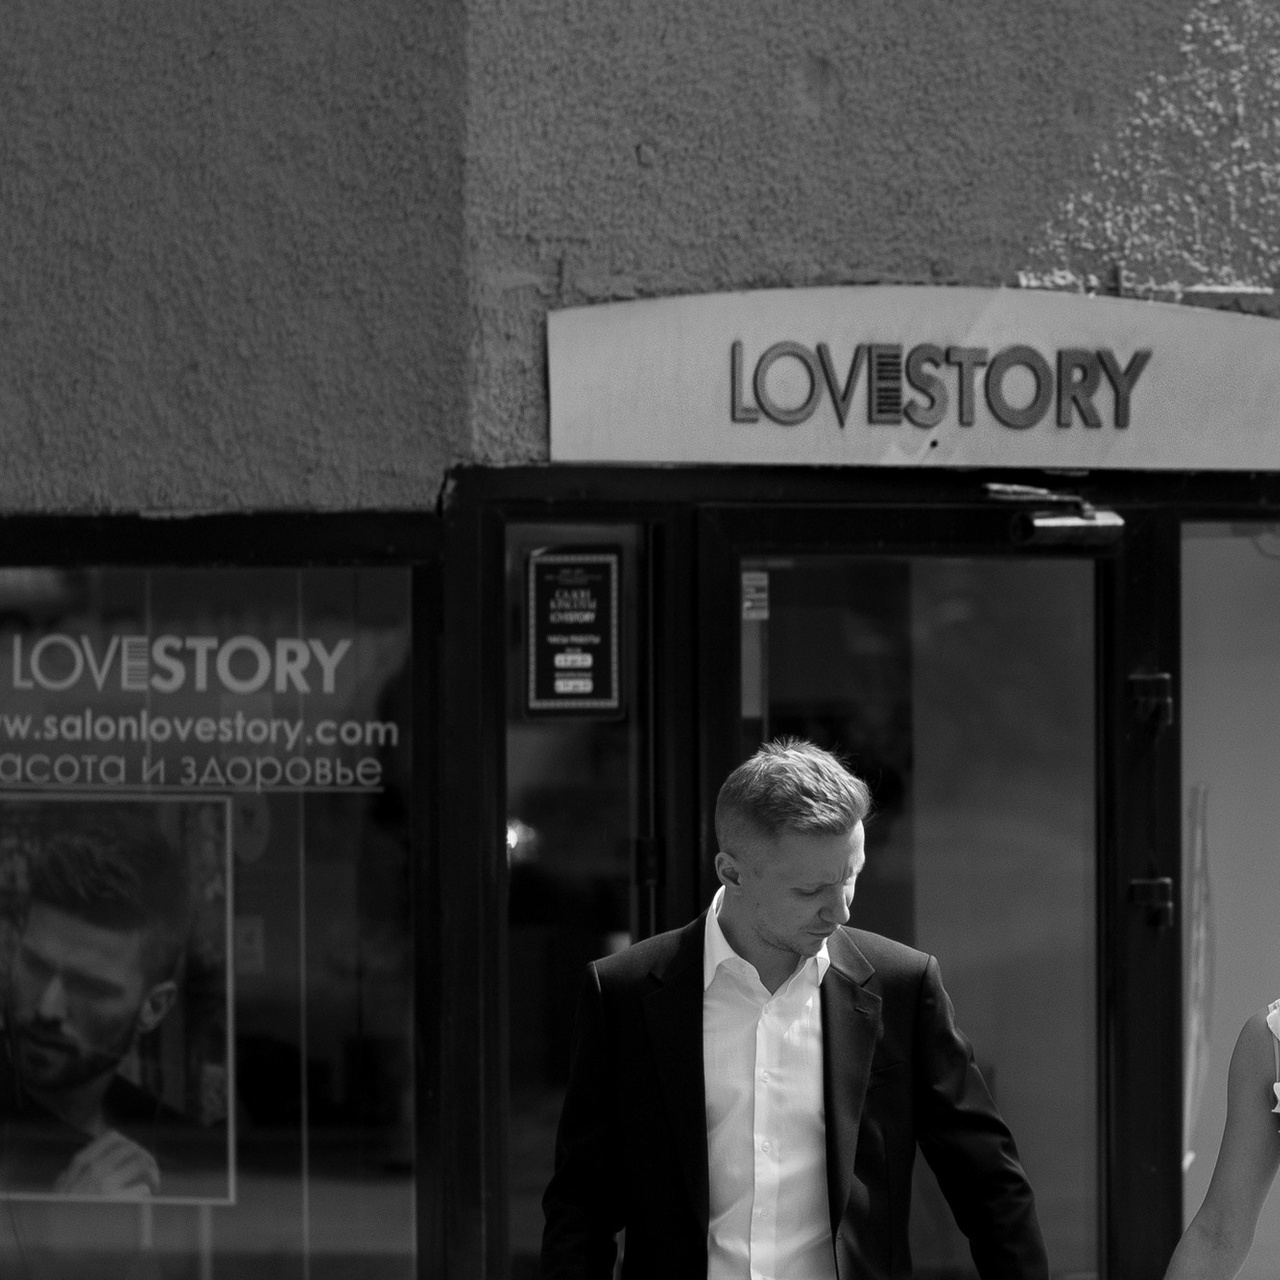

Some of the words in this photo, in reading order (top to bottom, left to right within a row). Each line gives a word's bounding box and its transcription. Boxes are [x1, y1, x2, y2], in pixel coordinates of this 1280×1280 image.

[729, 339, 1154, 431] LOVESTORY
[12, 633, 353, 694] LOVESTORY
[0, 708, 399, 751] w.salonlovestory.com
[142, 756, 165, 784] и
[180, 756, 383, 794] здоровье
